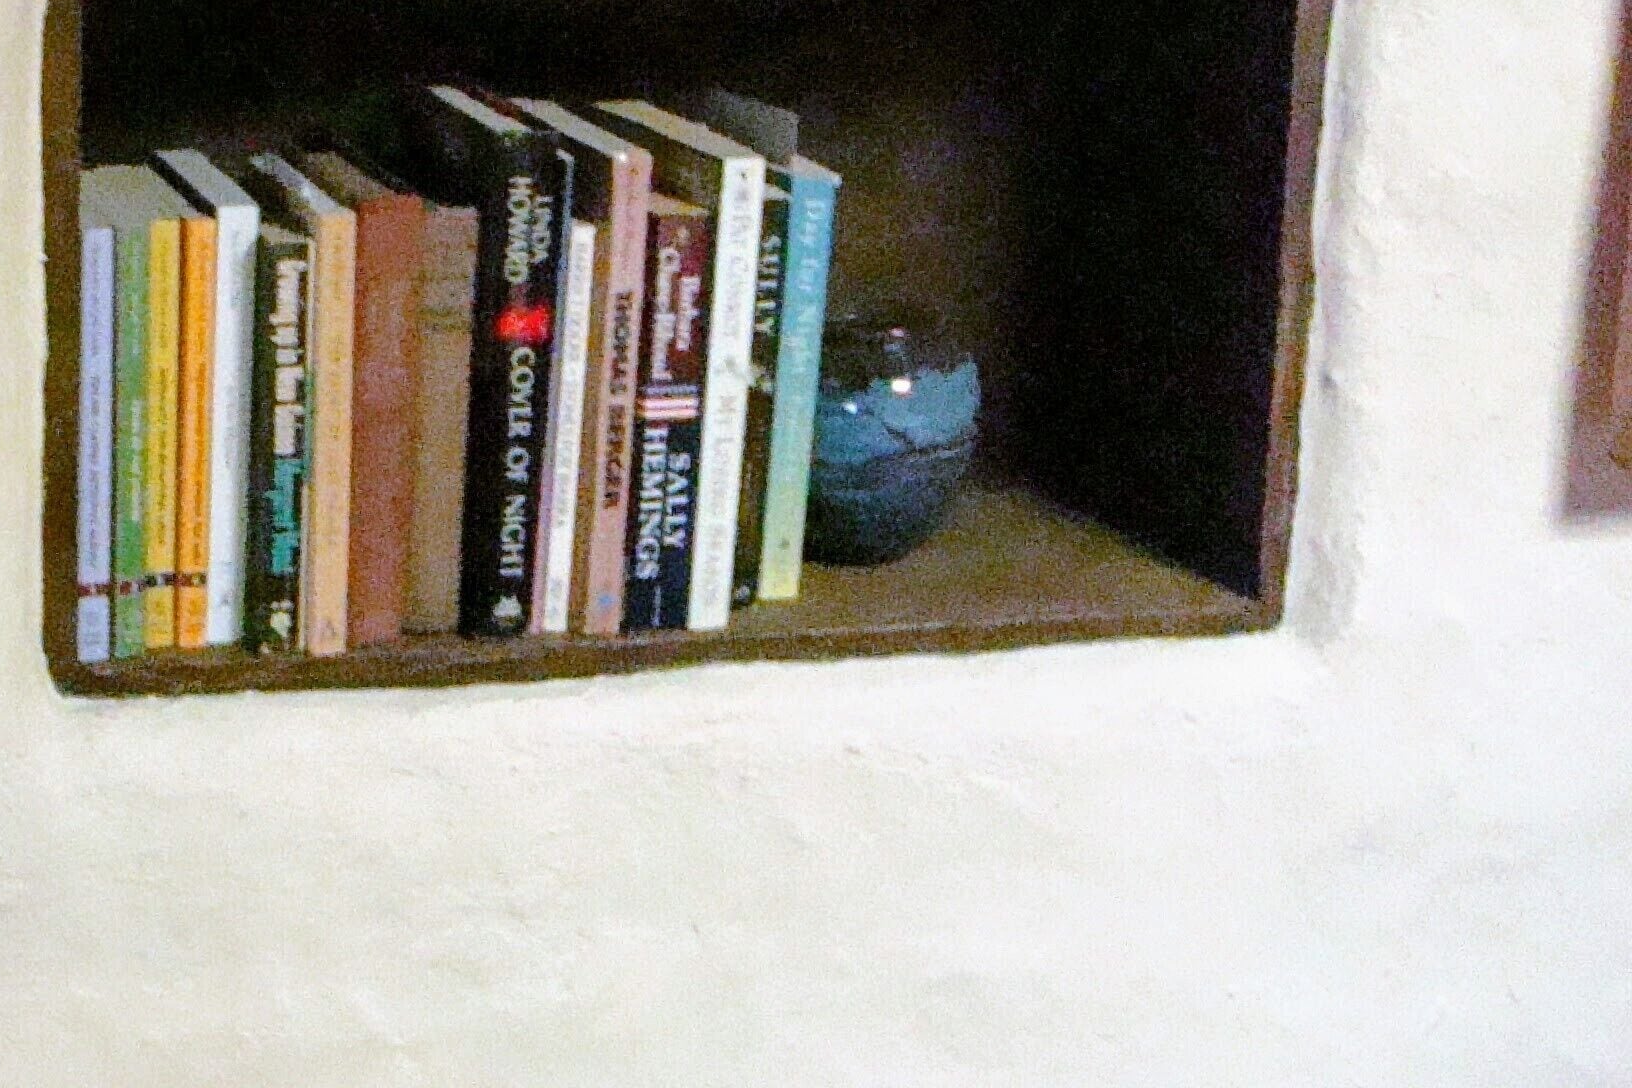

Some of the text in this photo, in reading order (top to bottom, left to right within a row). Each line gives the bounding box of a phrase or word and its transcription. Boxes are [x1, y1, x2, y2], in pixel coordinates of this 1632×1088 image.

[505, 176, 533, 286] HOWARD
[527, 195, 554, 264] LINDA
[609, 290, 631, 401] THOMAS
[504, 449, 530, 488] OF
[635, 426, 668, 581] HEMINGS
[665, 451, 692, 549] SALLY
[498, 493, 528, 579] NIGHT
